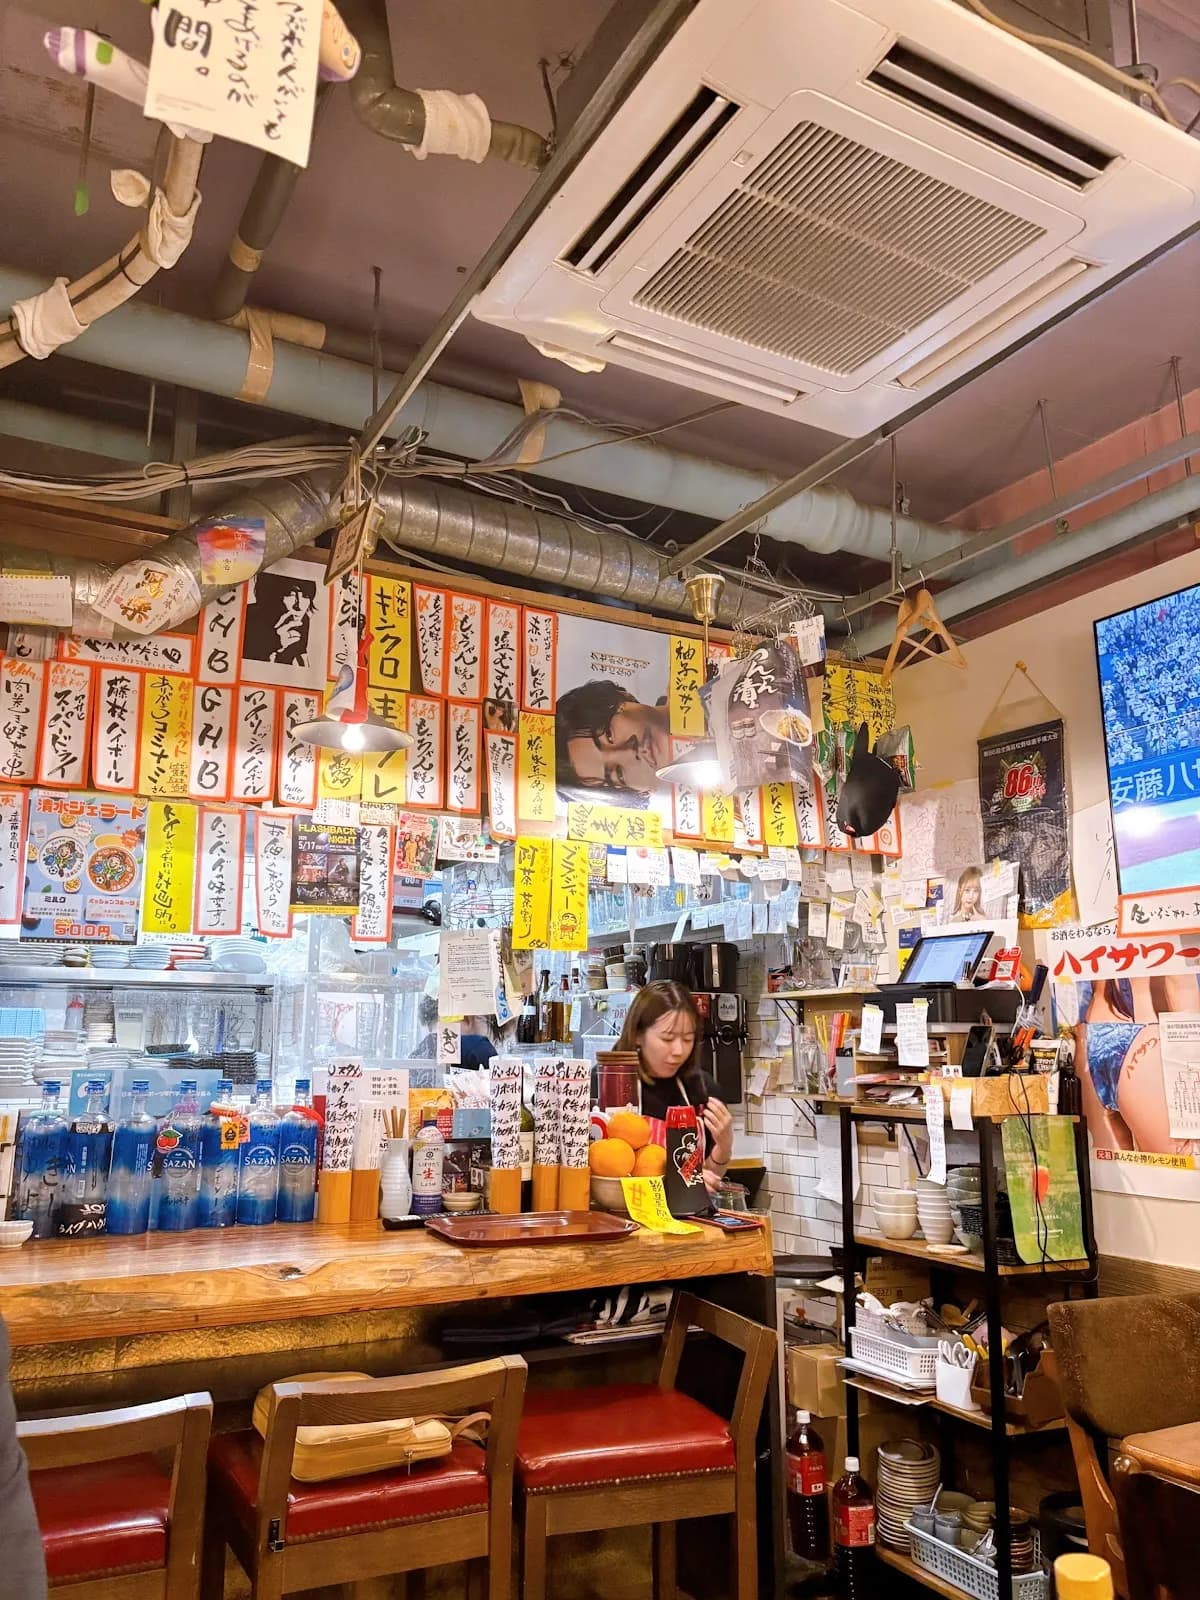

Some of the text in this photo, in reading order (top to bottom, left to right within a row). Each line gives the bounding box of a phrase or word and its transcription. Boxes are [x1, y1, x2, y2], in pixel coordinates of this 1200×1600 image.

[493, 630, 515, 700] 塩むすび
[675, 640, 699, 729] 柚子ジャムサワー
[48, 689, 79, 779] スーパードライ
[107, 675, 132, 784] 藤枝ハイボール
[1003, 764, 1034, 799] 86
[1111, 760, 1200, 809] 安藤ハ
[36, 798, 145, 820] 清水ジェラート
[298, 824, 357, 836] FLASHBACK
[328, 835, 357, 845] NIGHT
[298, 841, 316, 850] 5/17
[1053, 941, 1200, 977] ハイサワー
[163, 1158, 196, 1170] SAZAN
[244, 1156, 277, 1166] SAZAN
[280, 1154, 311, 1165] SAZAN
[423, 1168, 435, 1180] 生
